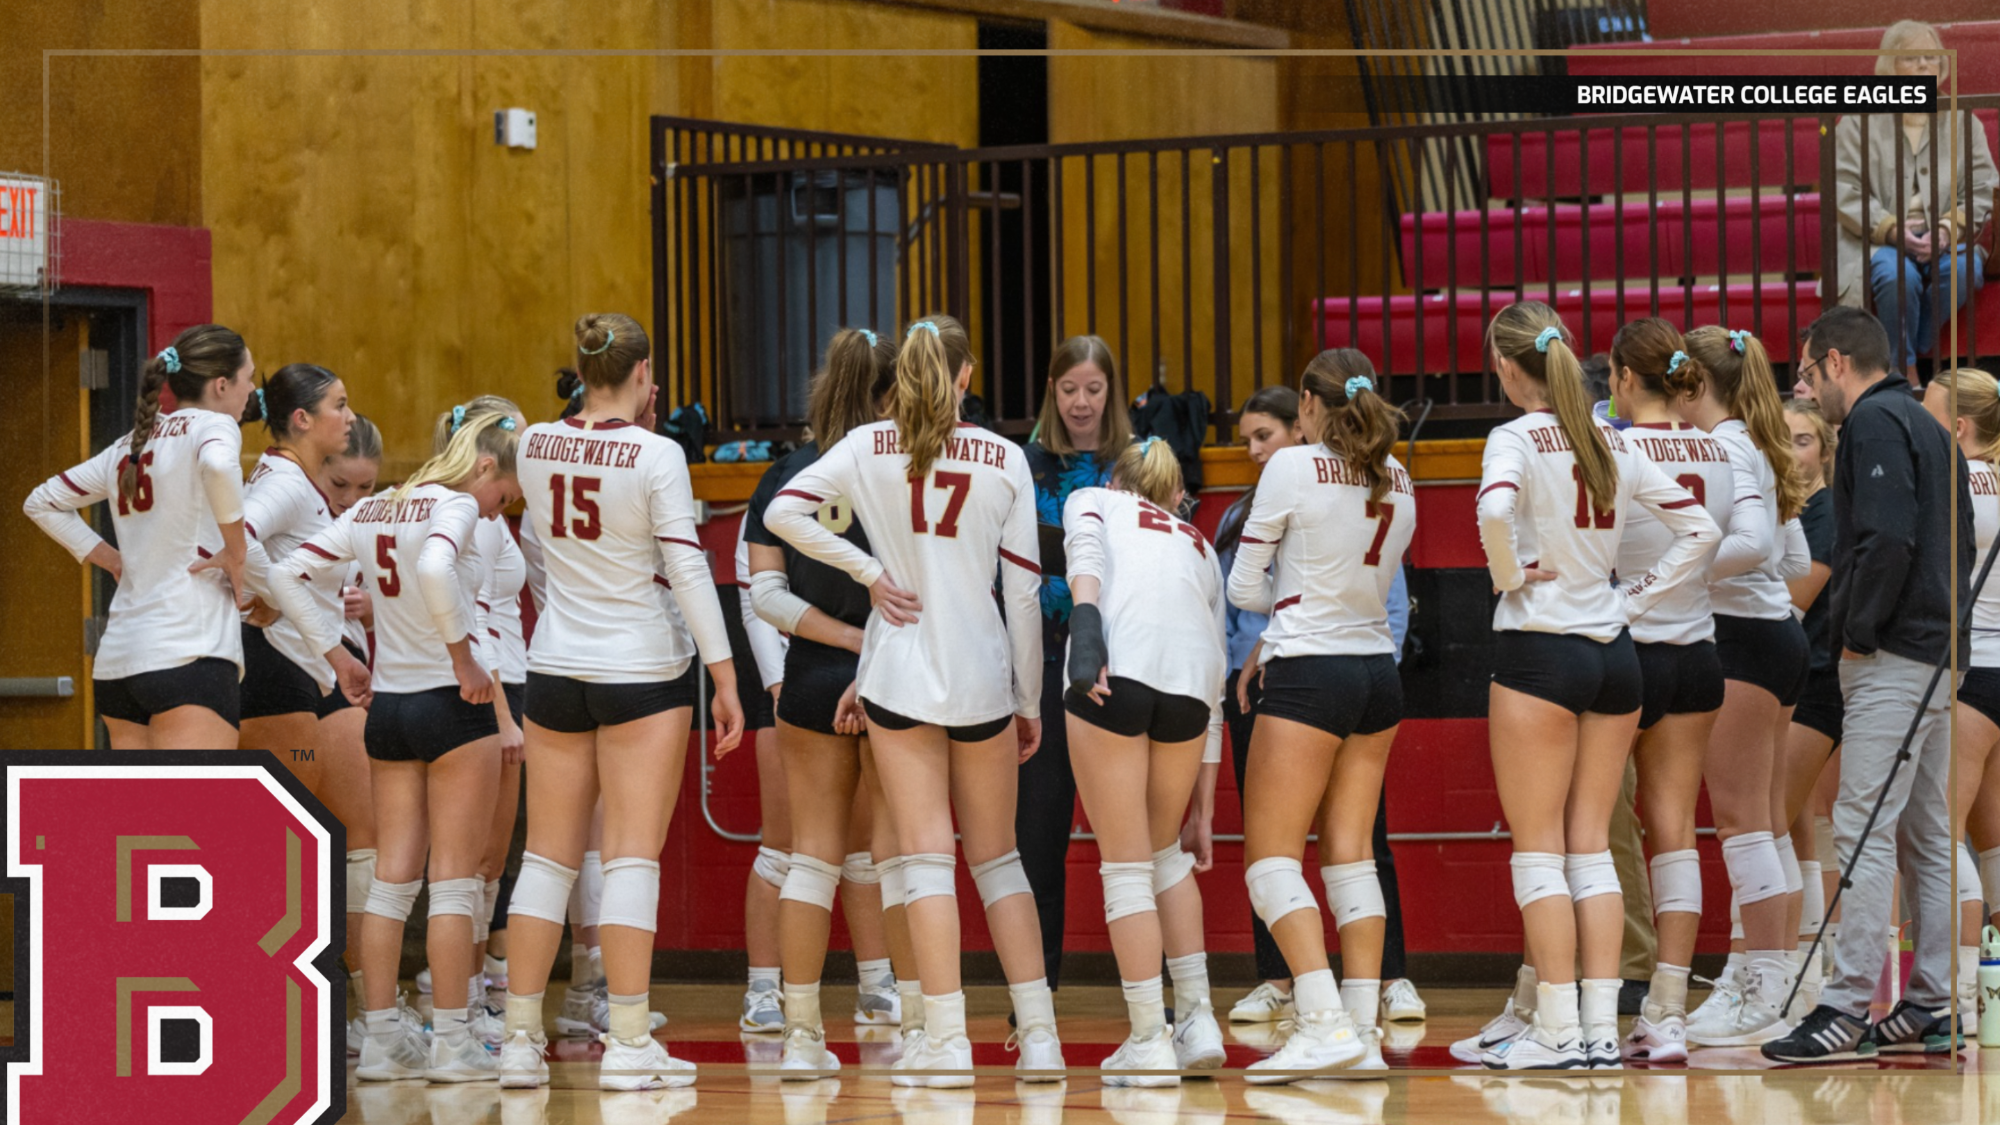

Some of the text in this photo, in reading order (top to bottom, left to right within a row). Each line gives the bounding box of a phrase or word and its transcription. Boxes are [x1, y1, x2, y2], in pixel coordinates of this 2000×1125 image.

[0, 186, 37, 239] EXIT
[525, 432, 642, 469] BRIDGEWATER
[873, 430, 1006, 470] BRWATER
[1633, 437, 1731, 464] IDGEWATE
[549, 473, 602, 541] 15
[907, 468, 972, 539] 17
[1572, 464, 1617, 530] 1
[1363, 500, 1395, 567] 7
[376, 534, 400, 598] 5
